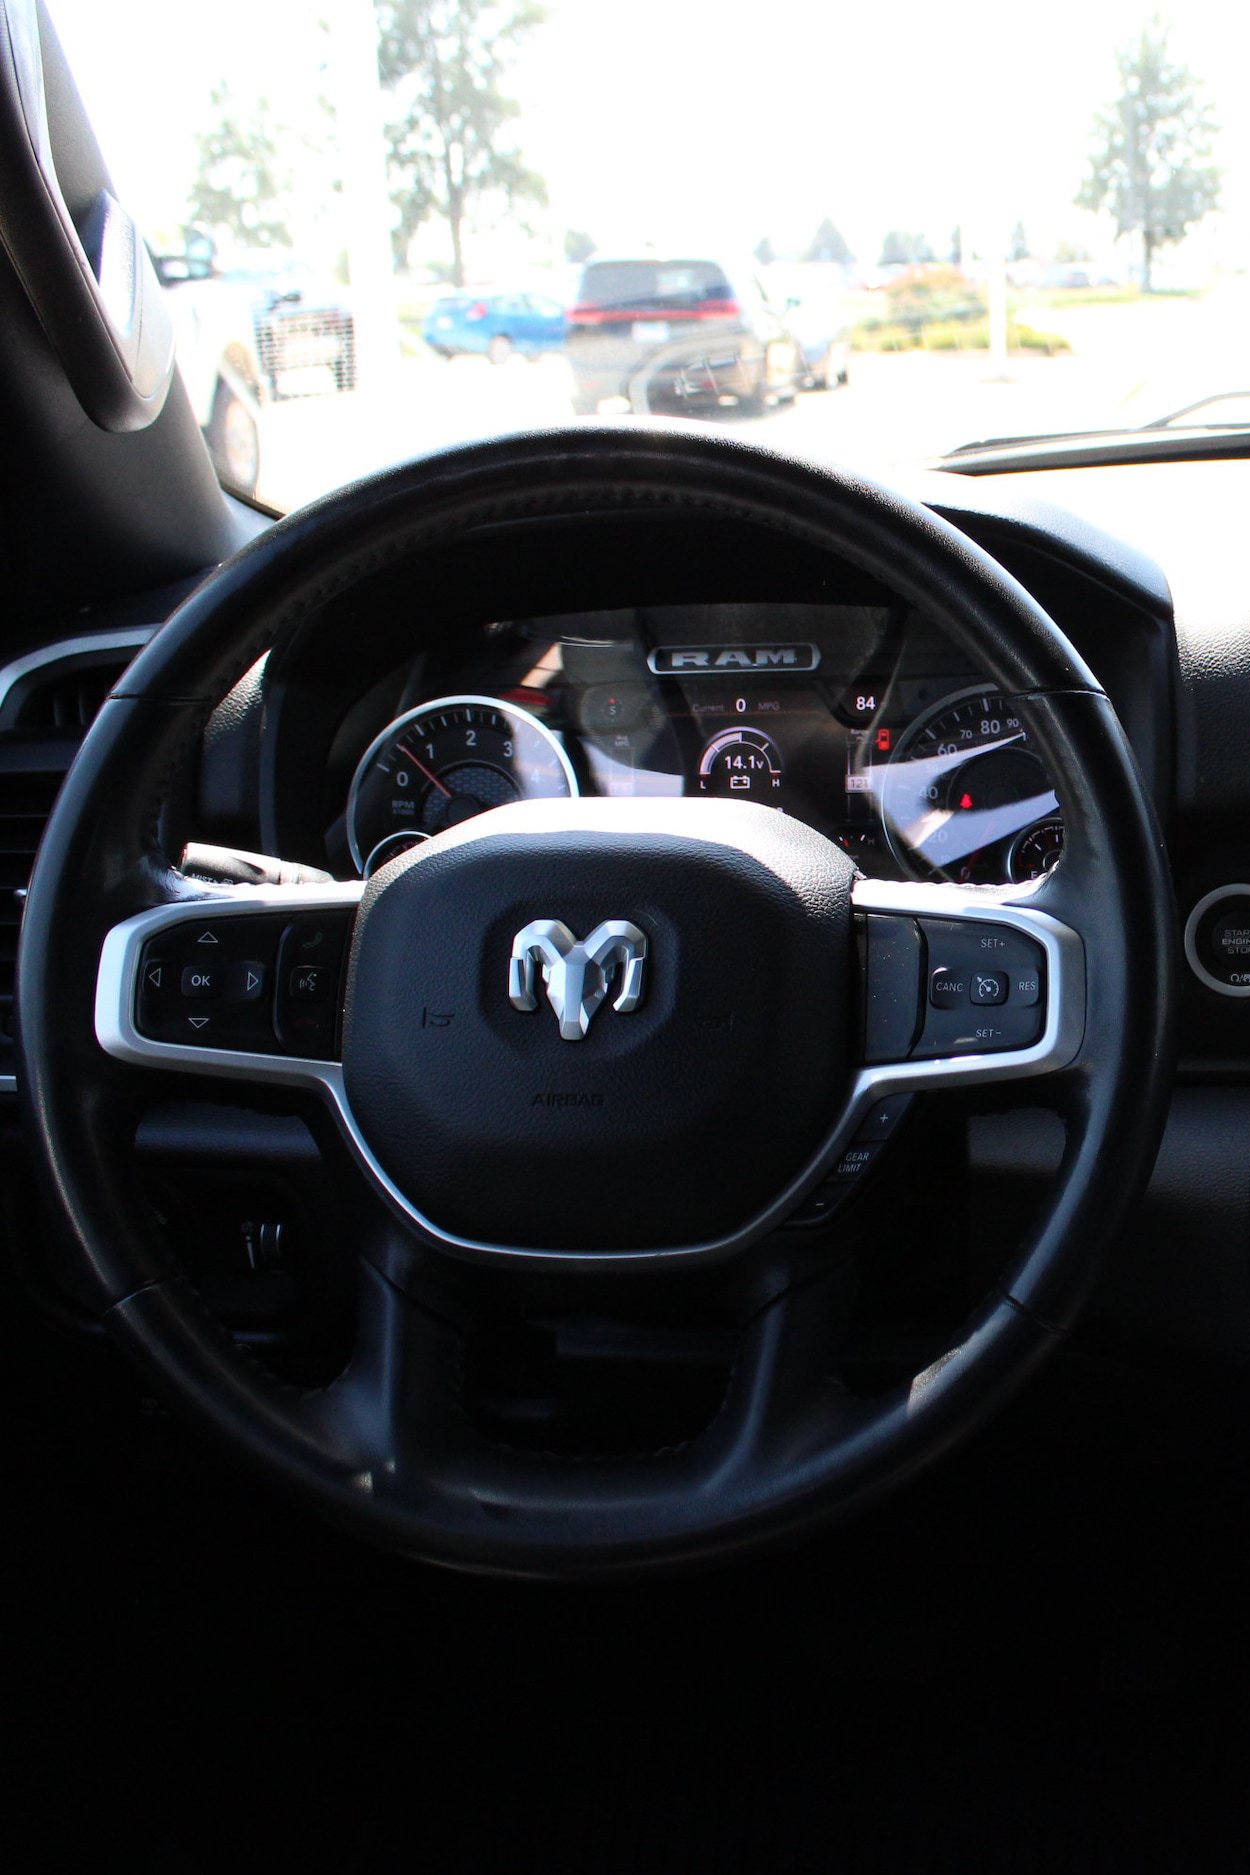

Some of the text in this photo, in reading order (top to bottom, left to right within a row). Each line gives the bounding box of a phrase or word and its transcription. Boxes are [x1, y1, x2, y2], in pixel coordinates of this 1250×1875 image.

[671, 649, 797, 667] RAM
[736, 698, 747, 713] 0
[856, 695, 876, 710] 84
[980, 719, 1000, 734] 80
[1006, 718, 1019, 728] 90
[466, 730, 477, 746] 2
[960, 730, 973, 740] 70
[425, 743, 435, 760] 1
[503, 741, 513, 758] 3
[937, 743, 957, 757] 60
[396, 771, 409, 787] 0
[191, 975, 210, 987] OK
[935, 982, 963, 993] CANC
[1018, 981, 1036, 991] RES
[531, 1093, 605, 1107] AIRBAG
[846, 1152, 870, 1161] GEAR
[837, 1163, 862, 1173] LIMIT
